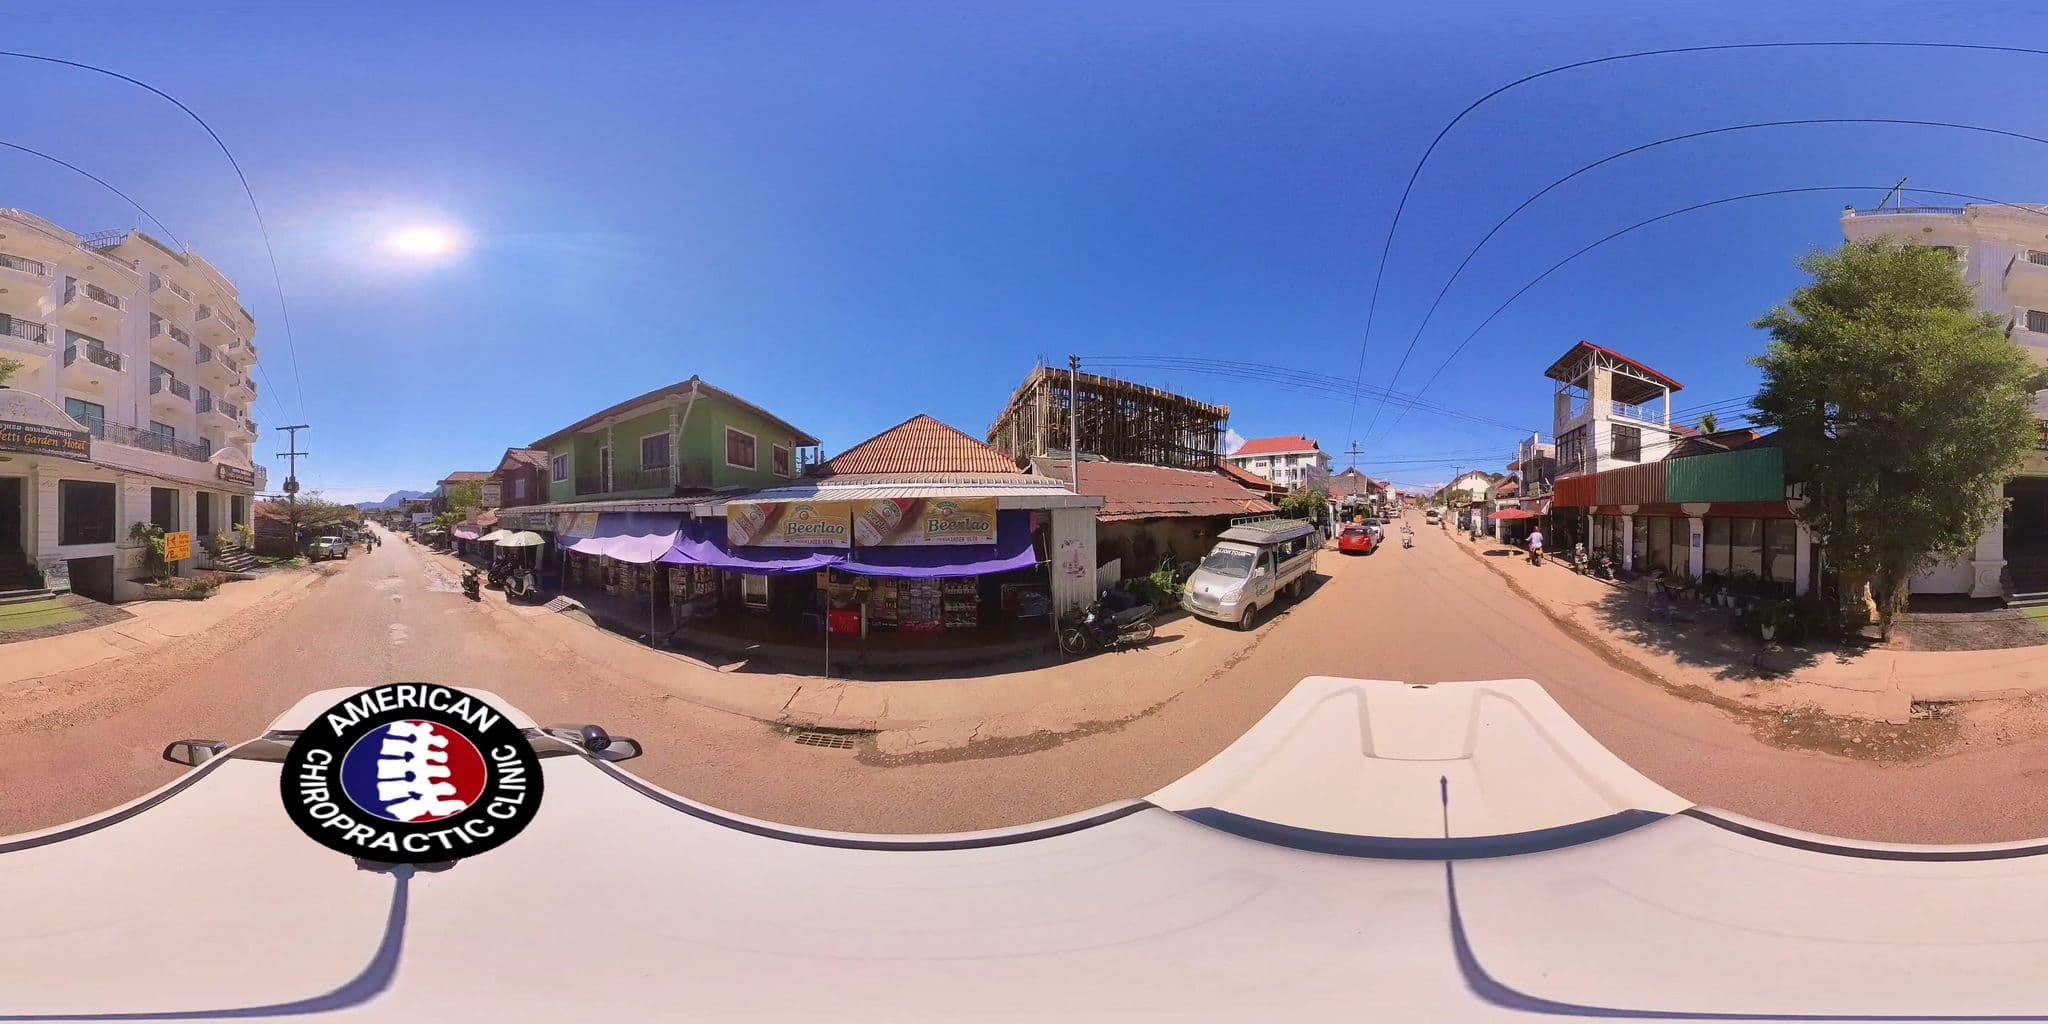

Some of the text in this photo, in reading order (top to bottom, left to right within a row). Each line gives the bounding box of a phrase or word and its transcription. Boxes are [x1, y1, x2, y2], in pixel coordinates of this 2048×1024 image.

[24, 433, 59, 446] Garden
[62, 437, 85, 450] Hotel
[787, 521, 844, 535] Beerlao
[927, 518, 990, 533] Beerlao
